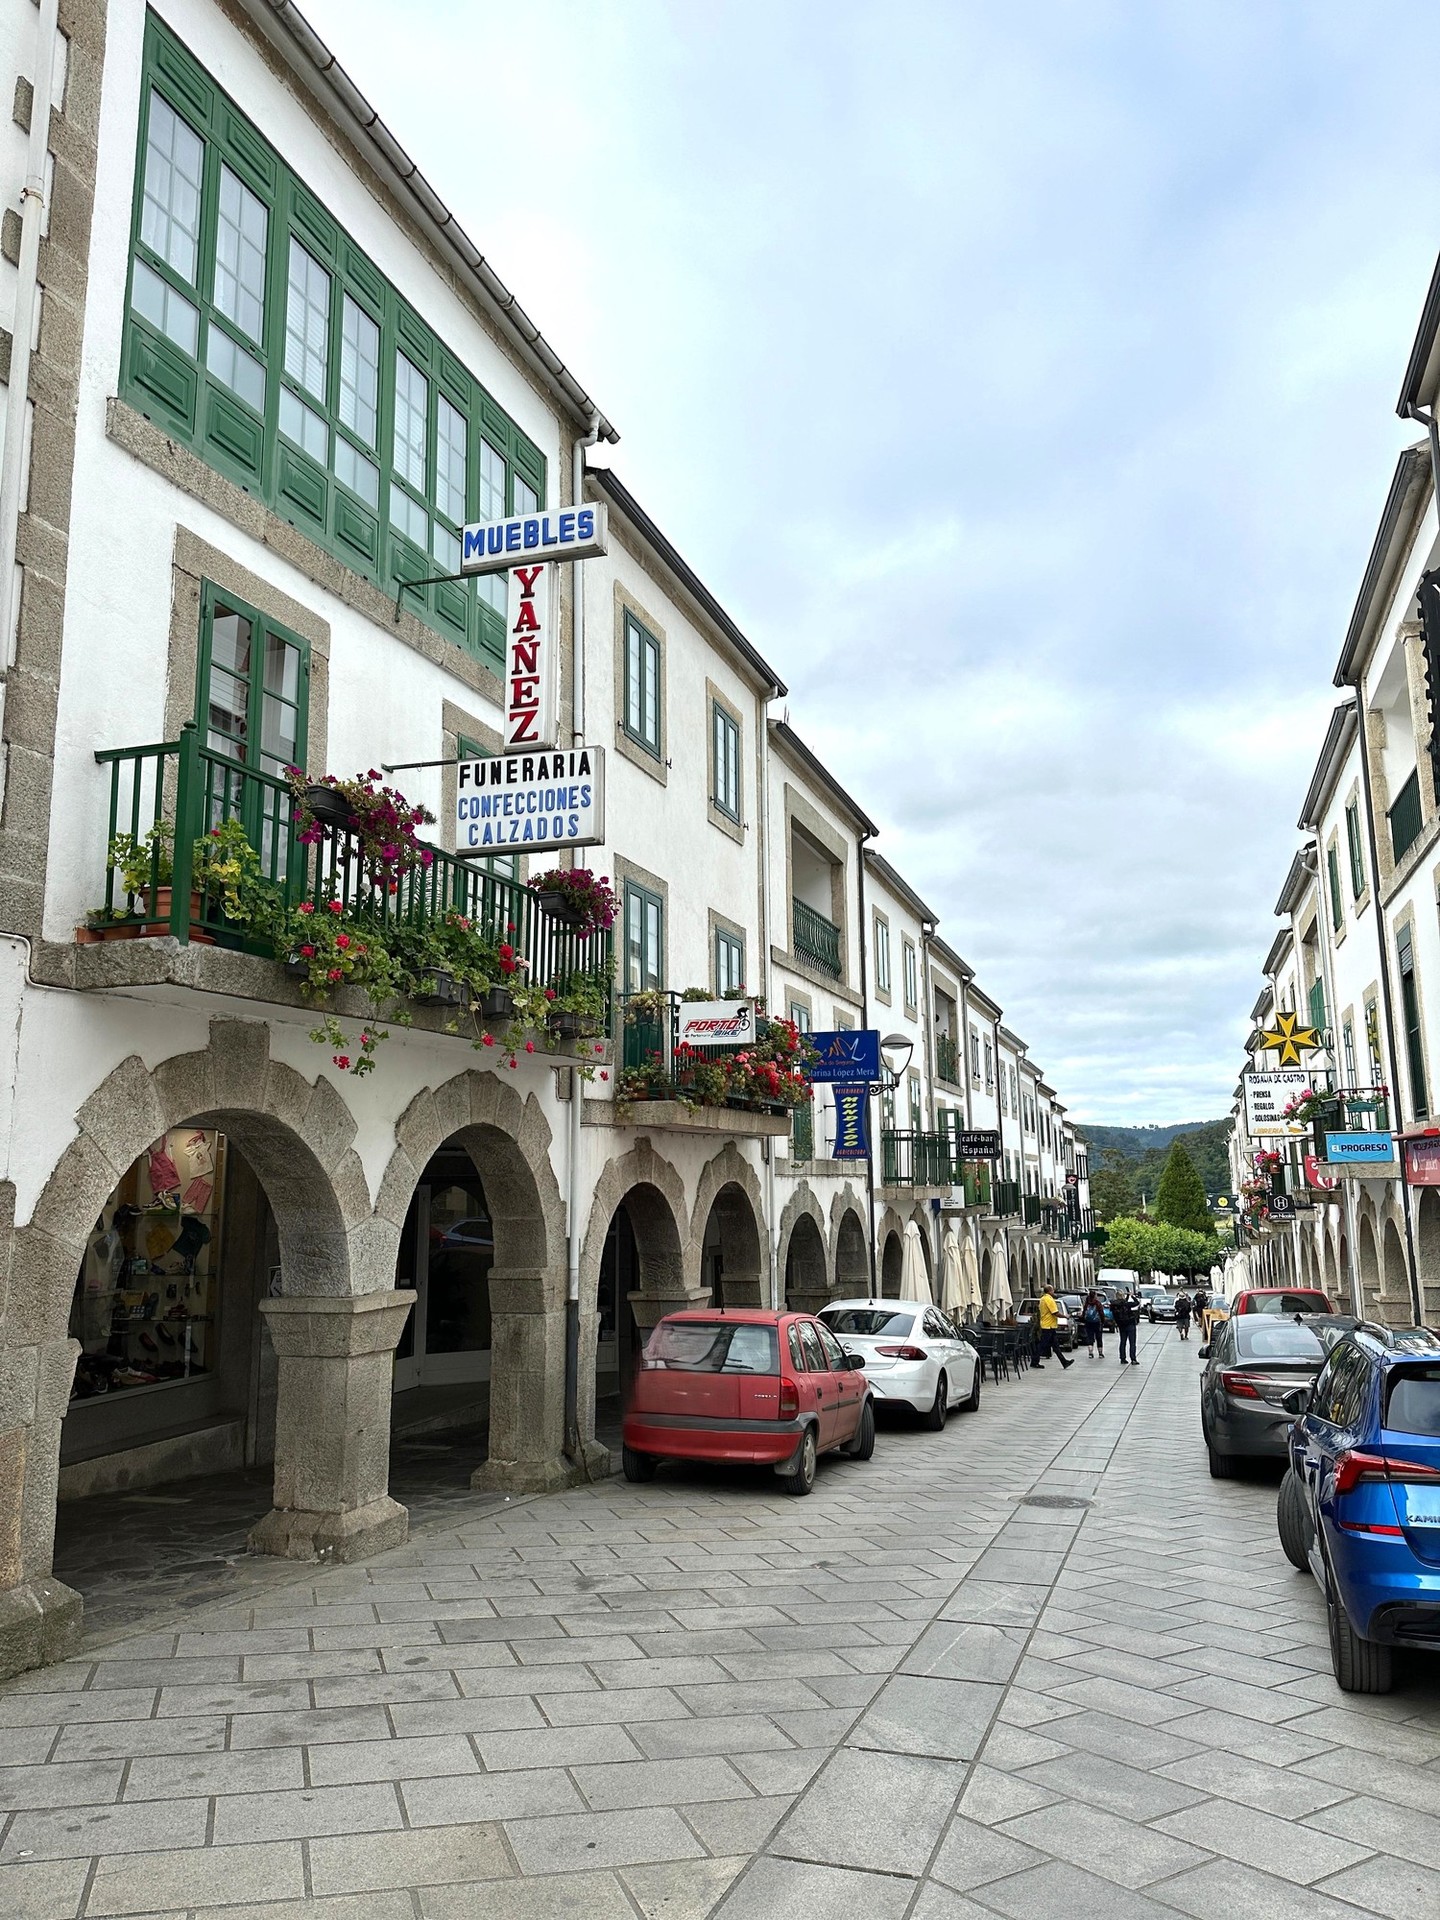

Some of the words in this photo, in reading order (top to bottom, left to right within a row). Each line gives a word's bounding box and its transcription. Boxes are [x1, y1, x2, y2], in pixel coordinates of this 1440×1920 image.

[464, 510, 594, 559] MUEBLES
[509, 565, 544, 744] YAÑEZ
[459, 751, 591, 788] FUNERARIA
[458, 784, 591, 820] CONFECCIONES
[468, 814, 579, 846] CALZADOS
[684, 1019, 740, 1032] PORTO
[832, 1067, 855, 1078] López
[856, 1067, 875, 1076] Mera
[1283, 1074, 1306, 1083] CASTRO
[1253, 1090, 1271, 1099] PRENSA
[1254, 1102, 1275, 1110] REGALOS
[1255, 1114, 1280, 1122] GOLOSINAS
[962, 1134, 993, 1142] café-bar
[962, 1145, 994, 1155] España
[1331, 1144, 1341, 1153] EL
[1341, 1143, 1388, 1152] PROGRESO
[1405, 1515, 1440, 1523] KAMI
